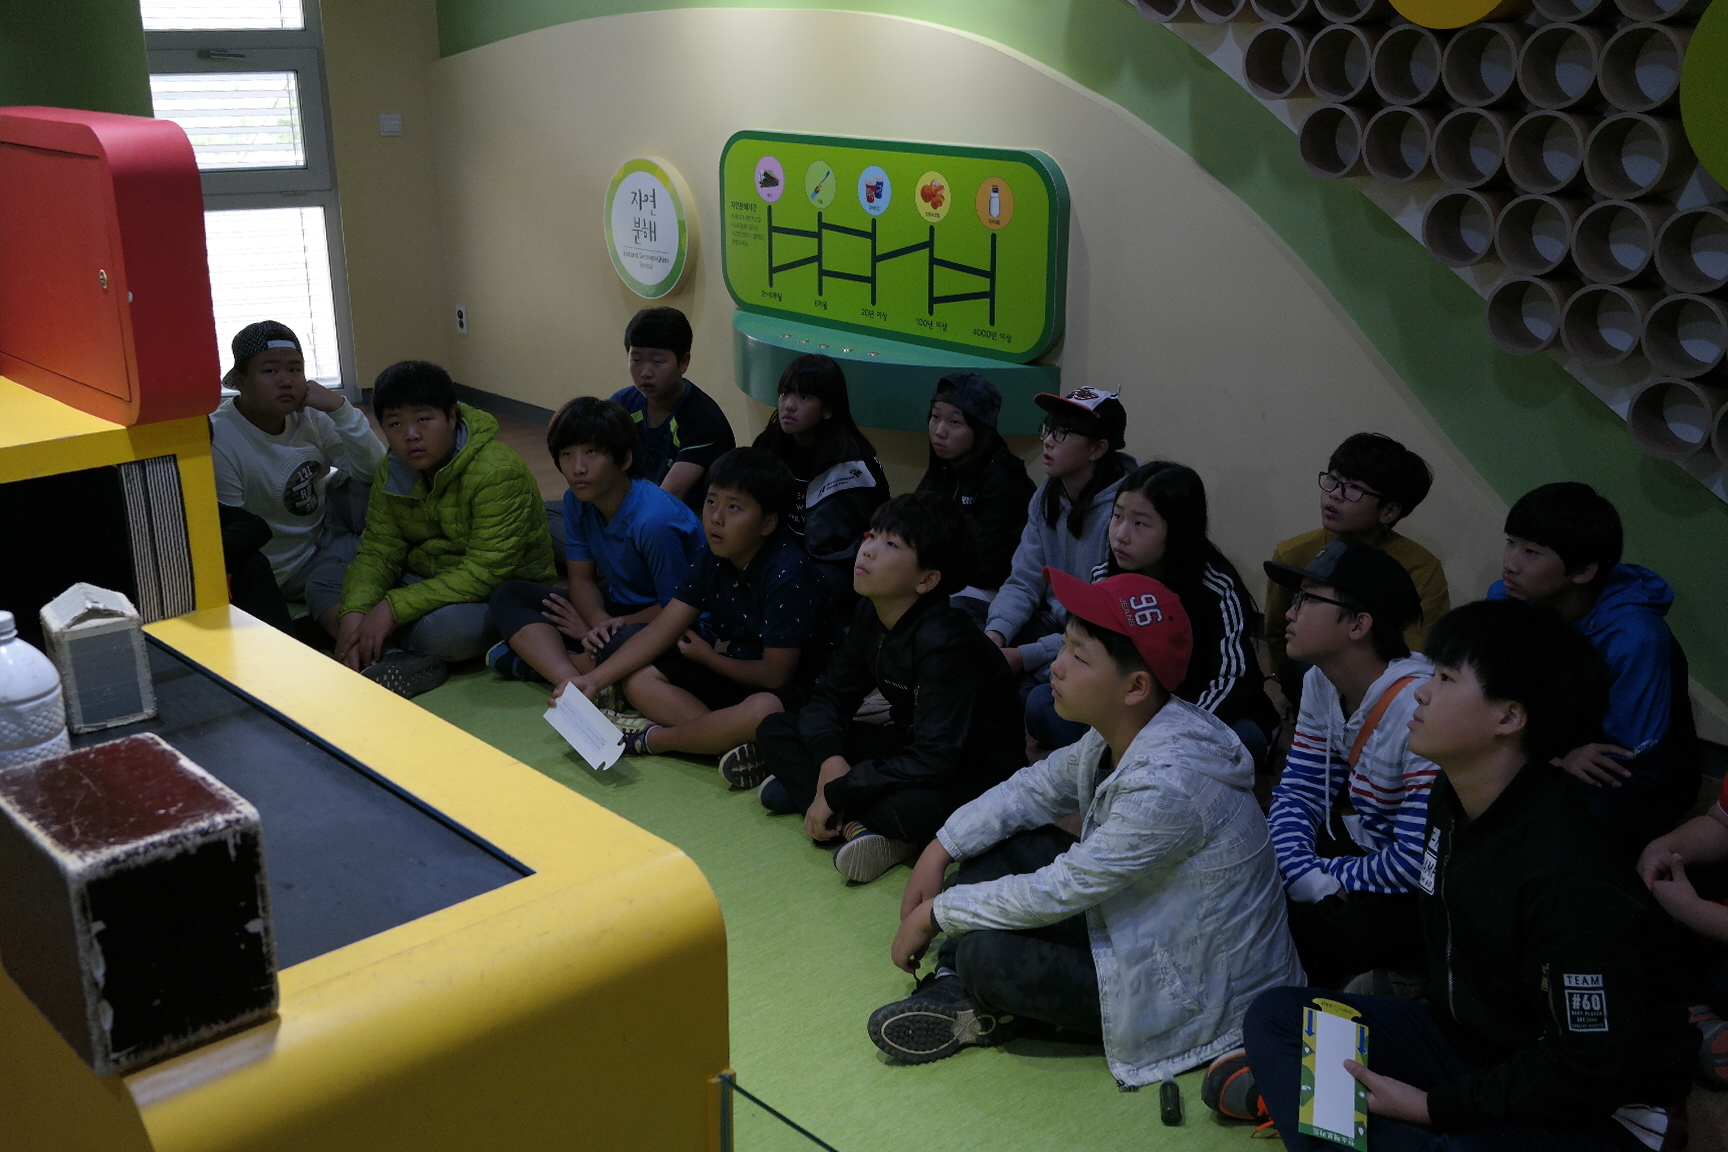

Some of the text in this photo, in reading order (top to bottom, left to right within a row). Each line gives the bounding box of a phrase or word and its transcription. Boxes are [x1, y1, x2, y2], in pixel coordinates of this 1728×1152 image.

[630, 188, 657, 216] 자연
[631, 216, 657, 245] 분해
[861, 308, 888, 322] 20년 이상
[915, 317, 948, 332] 100년 이상
[972, 328, 1013, 344] 4000년 이상
[1118, 597, 1135, 627] JEANS
[1129, 593, 1164, 627] 96
[1566, 975, 1601, 986] TEAM
[1571, 994, 1602, 1011] #60
